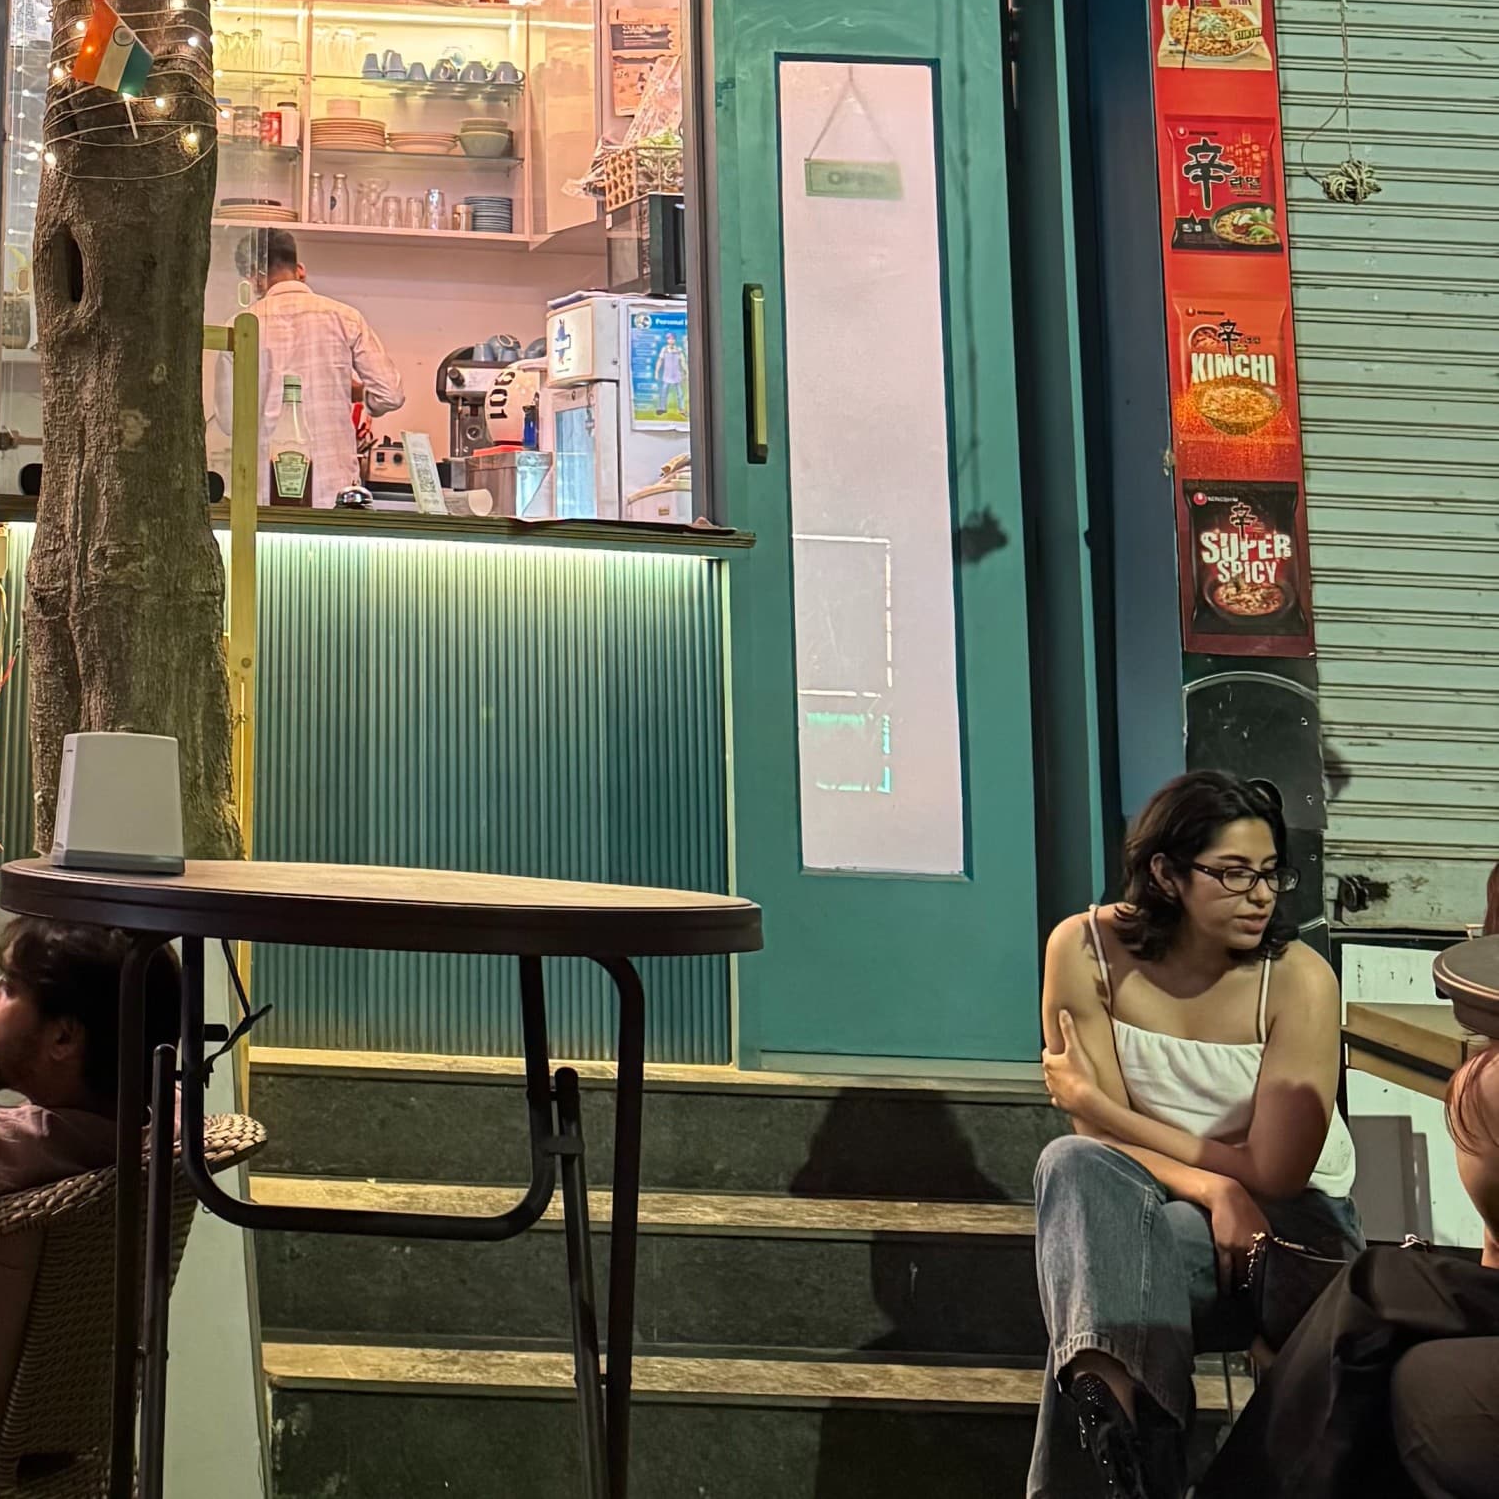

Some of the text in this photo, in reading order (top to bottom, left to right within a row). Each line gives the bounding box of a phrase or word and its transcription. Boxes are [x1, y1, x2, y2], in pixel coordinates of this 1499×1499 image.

[1191, 353, 1277, 386] KIMCHI
[489, 371, 516, 419] 901
[1200, 531, 1292, 564] SUPER
[1217, 560, 1278, 584] SPICY
